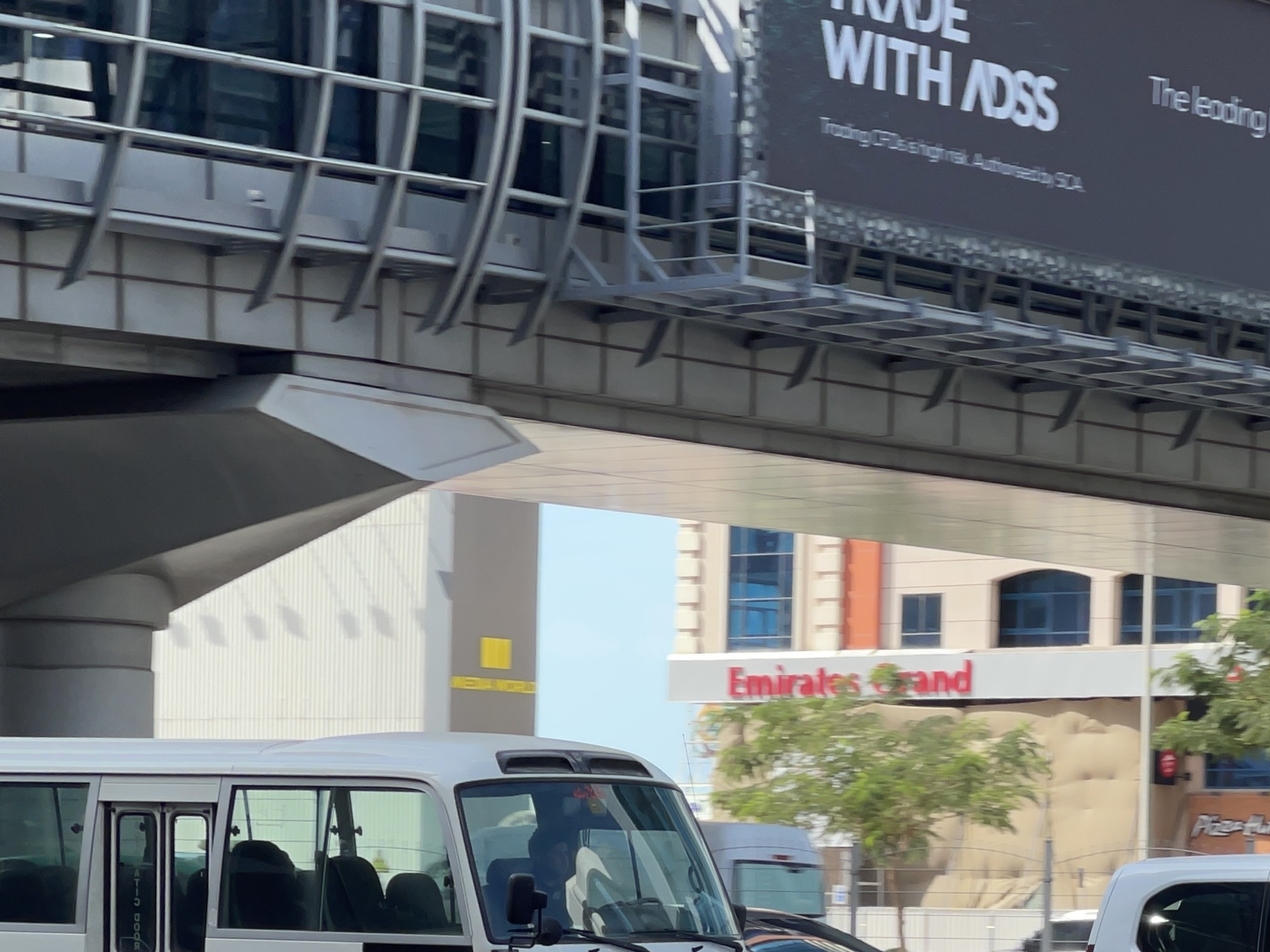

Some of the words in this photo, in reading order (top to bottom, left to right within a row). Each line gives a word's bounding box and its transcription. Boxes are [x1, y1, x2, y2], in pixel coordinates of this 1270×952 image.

[820, 19, 953, 107] WITH
[960, 58, 1060, 132] ADSS
[1148, 75, 1190, 112] The
[1191, 85, 1267, 138] leading
[727, 664, 861, 700] Emirates
[869, 659, 974, 697] and
[1191, 814, 1244, 837] Pizza
